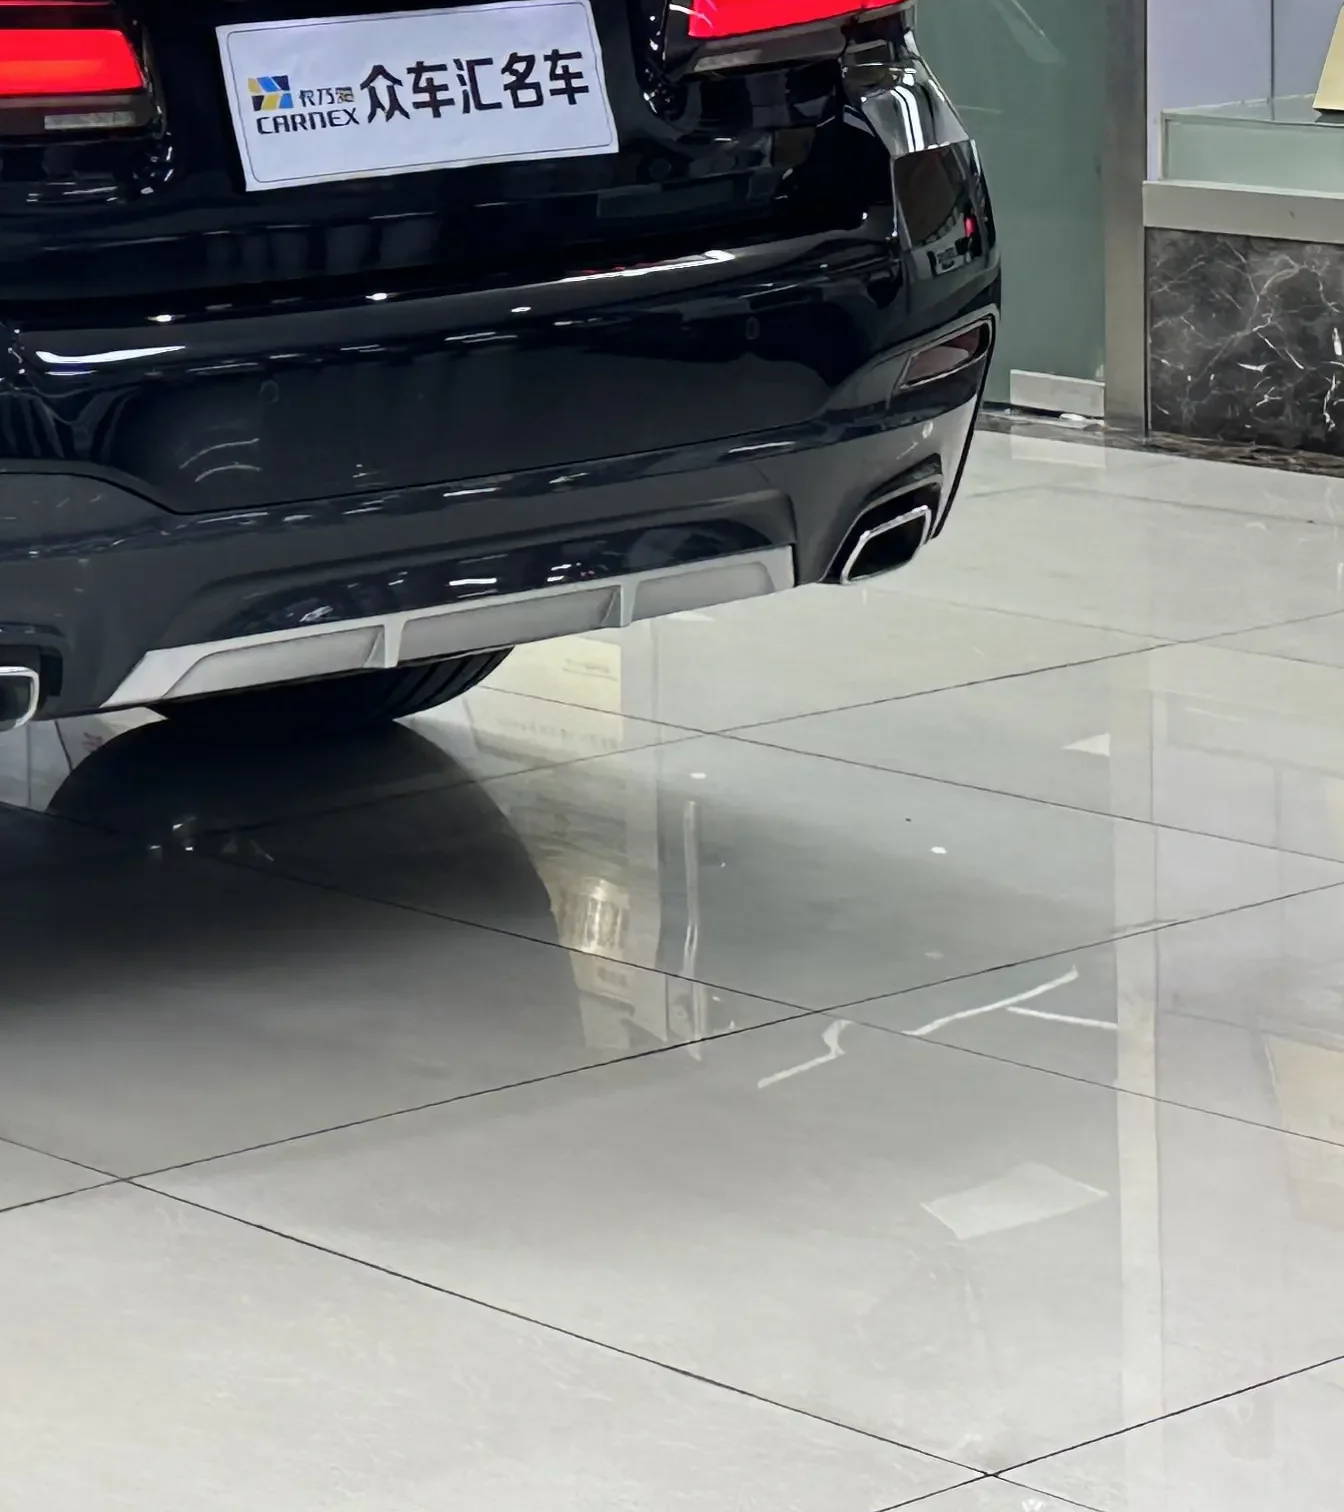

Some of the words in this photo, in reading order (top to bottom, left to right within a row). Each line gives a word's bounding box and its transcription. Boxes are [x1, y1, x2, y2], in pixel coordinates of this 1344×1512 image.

[359, 48, 590, 124] 众车汇名车
[255, 107, 361, 135] CARNEX
